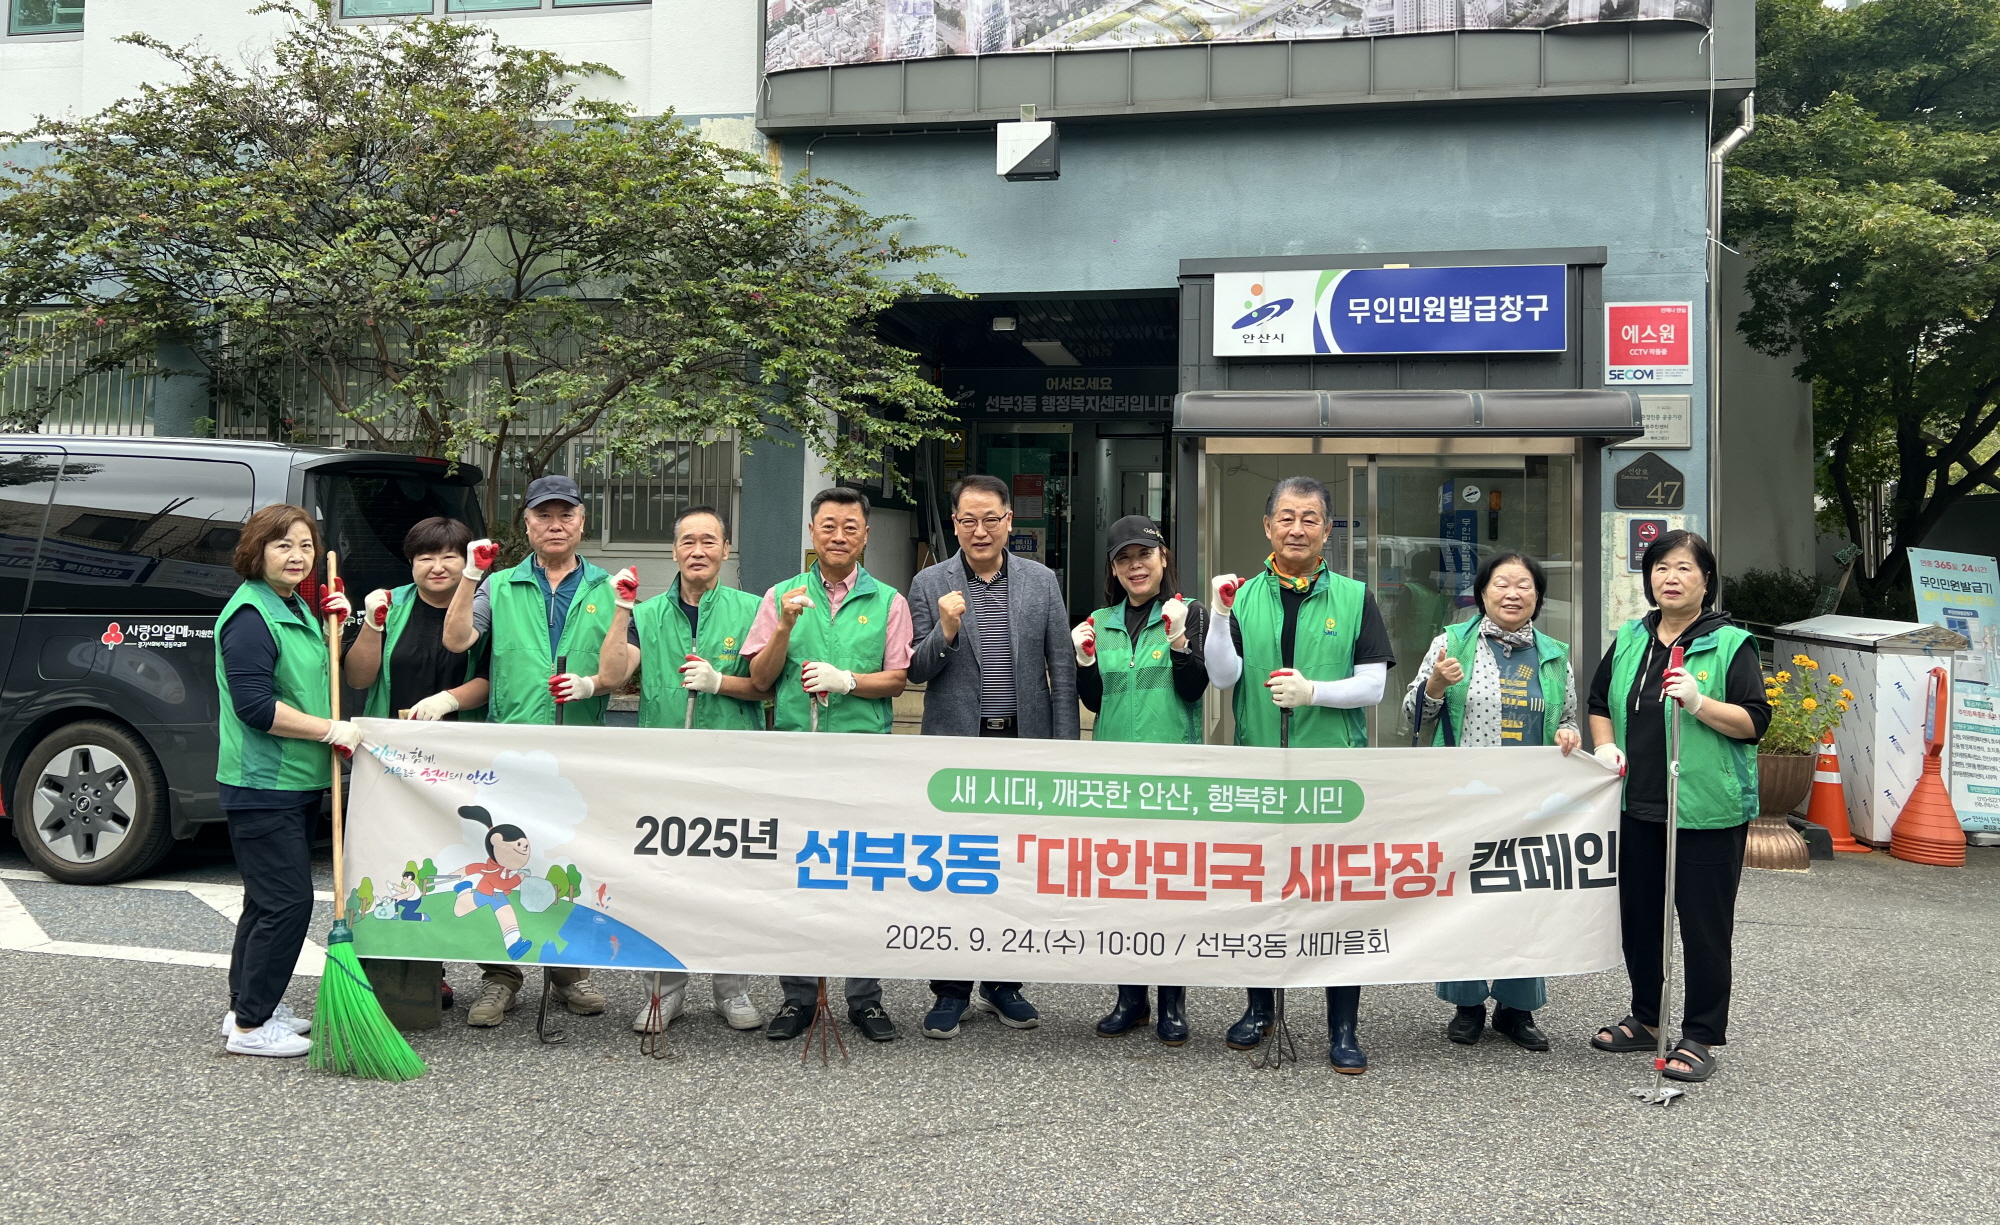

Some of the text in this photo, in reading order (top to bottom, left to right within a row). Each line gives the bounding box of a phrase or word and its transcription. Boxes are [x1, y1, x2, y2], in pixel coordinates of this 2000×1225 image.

[1347, 294, 1550, 324] 무인민원발급창구
[1241, 333, 1285, 344] 안산시
[1621, 324, 1675, 344] 에스원
[1629, 348, 1668, 356] CCTV 작동중
[1045, 377, 1113, 391] 어서오세요
[1609, 369, 1654, 380] SECOM
[985, 394, 1174, 412] 선부3동 행정복지센터입니다
[1646, 481, 1682, 505] 47
[1919, 576, 1993, 595] 무인민원발급기
[195, 629, 215, 639] 지원한
[383, 766, 500, 785] 자유로운 혁신도시 안산
[950, 775, 1344, 815] 새 시대, 깨끗한 안산, 행복한 시민
[633, 814, 779, 860] 2025년
[795, 829, 1001, 895] 선부3동
[1468, 830, 1618, 894] 캠페인
[885, 923, 1391, 959] 2025. 9. 24.(수) 10:00 / 선부3동 새마을회
